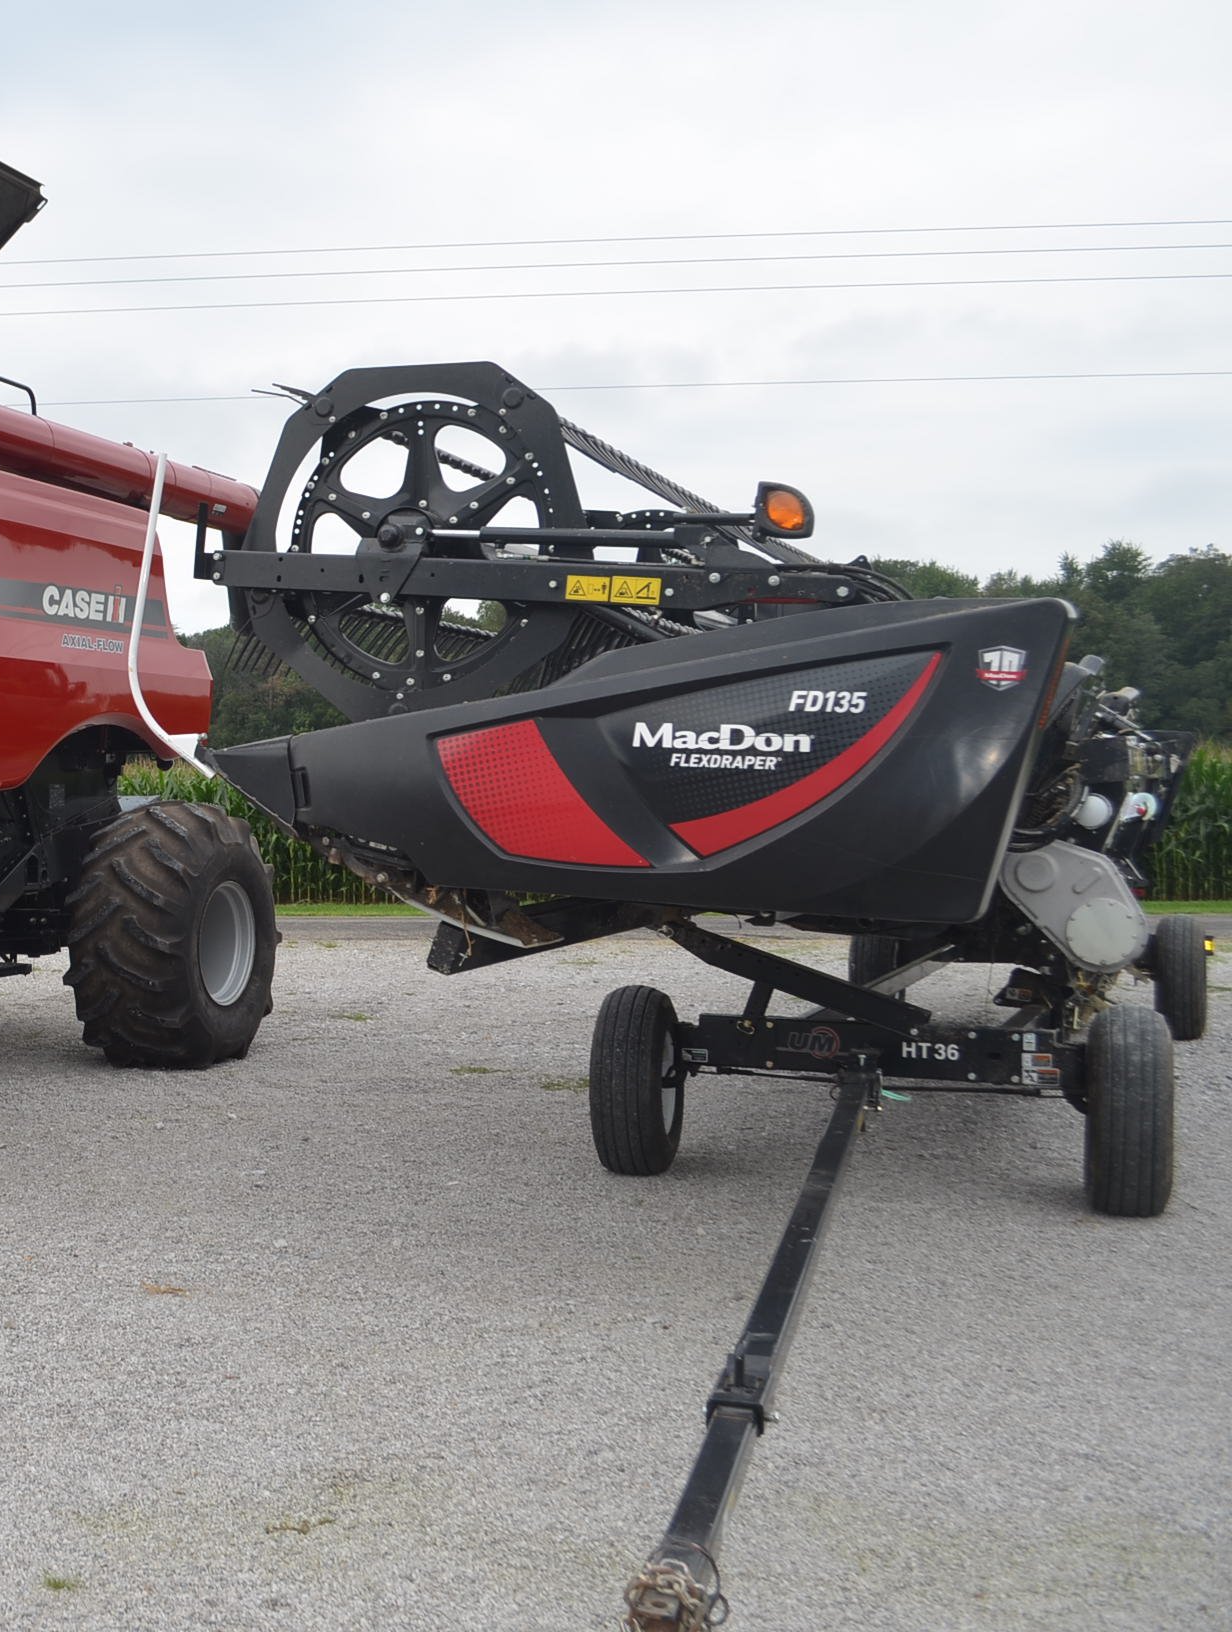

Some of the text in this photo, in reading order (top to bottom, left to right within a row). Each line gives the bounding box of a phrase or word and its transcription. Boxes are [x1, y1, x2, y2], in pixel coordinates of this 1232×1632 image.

[42, 585, 105, 621] CASE
[62, 634, 124, 653] AXIAL-FLOW
[788, 690, 867, 713] FD135
[632, 722, 811, 753] MacDon
[670, 753, 777, 770] FLEXDRAPER
[787, 1031, 836, 1054] UM
